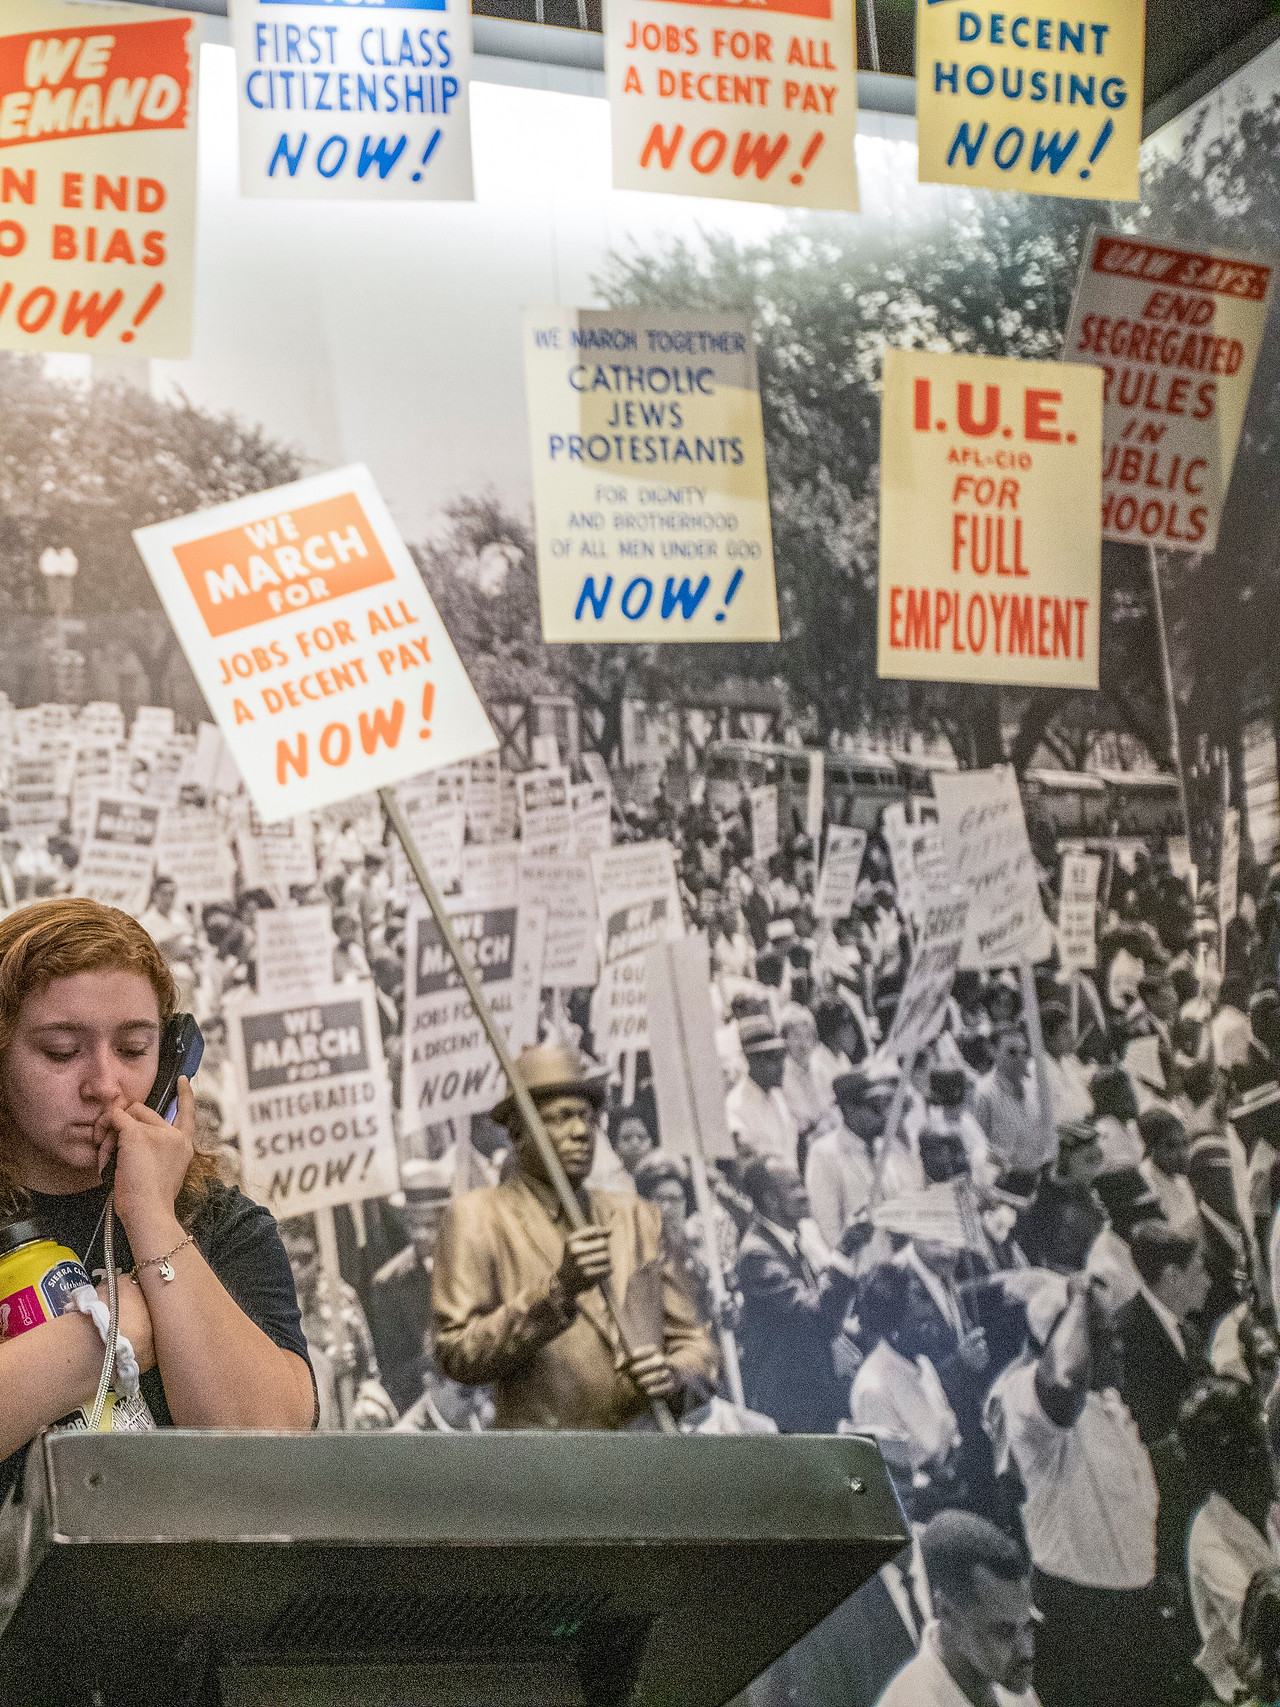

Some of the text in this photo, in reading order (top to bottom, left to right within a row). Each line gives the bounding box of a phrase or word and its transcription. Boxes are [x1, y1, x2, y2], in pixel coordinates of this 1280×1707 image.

[254, 22, 451, 70] FIRST CLASS
[624, 20, 838, 73] JOBS FOR ALL
[957, 11, 1110, 57] DECENT
[24, 35, 116, 89] WE
[933, 60, 1128, 110] HOUSING
[246, 70, 461, 115] CITIZENSHIP
[623, 65, 838, 116] A DECENT PAY
[266, 128, 442, 182] NOW!
[638, 122, 825, 187] NOW!
[945, 117, 1115, 181] NOW!
[60, 171, 167, 214] END
[51, 224, 168, 268] BIAS
[1141, 288, 1217, 327] END
[532, 327, 747, 354] WE MARCH TOGETHER
[1077, 312, 1245, 378] SEGREGATED
[568, 363, 716, 396] CATHOLIC
[607, 400, 684, 429] JEWS
[913, 377, 1077, 445] I.U.E.
[1123, 418, 1167, 444] IN
[548, 433, 745, 466] PROTESTANTS
[946, 446, 1033, 472] AFL-CIO
[1102, 445, 1208, 496] UBLIC
[595, 485, 706, 508] FOR DIGNITY
[951, 474, 1020, 511] FOR
[244, 512, 301, 550] WE
[568, 511, 739, 533] AND BROTHERHOOD
[203, 524, 369, 605] MARCH
[551, 539, 762, 561] OF ALL MEN UNDER GOD
[951, 512, 1030, 579] FULL
[267, 576, 330, 613] FOR
[574, 568, 743, 621] NOW!
[220, 600, 419, 685] JOBS FOR ALL
[889, 584, 1089, 661] EMPLOYMENT
[233, 635, 433, 726] A DECENT PAY
[276, 681, 434, 785] NOW!
[284, 1011, 320, 1034] WE
[252, 1026, 361, 1072] MARCH
[247, 1081, 375, 1125] INTEGRATED
[255, 1115, 378, 1159] SCHOOLS
[269, 1148, 375, 1201] NOW!
[48, 1267, 72, 1288] SIERRA
